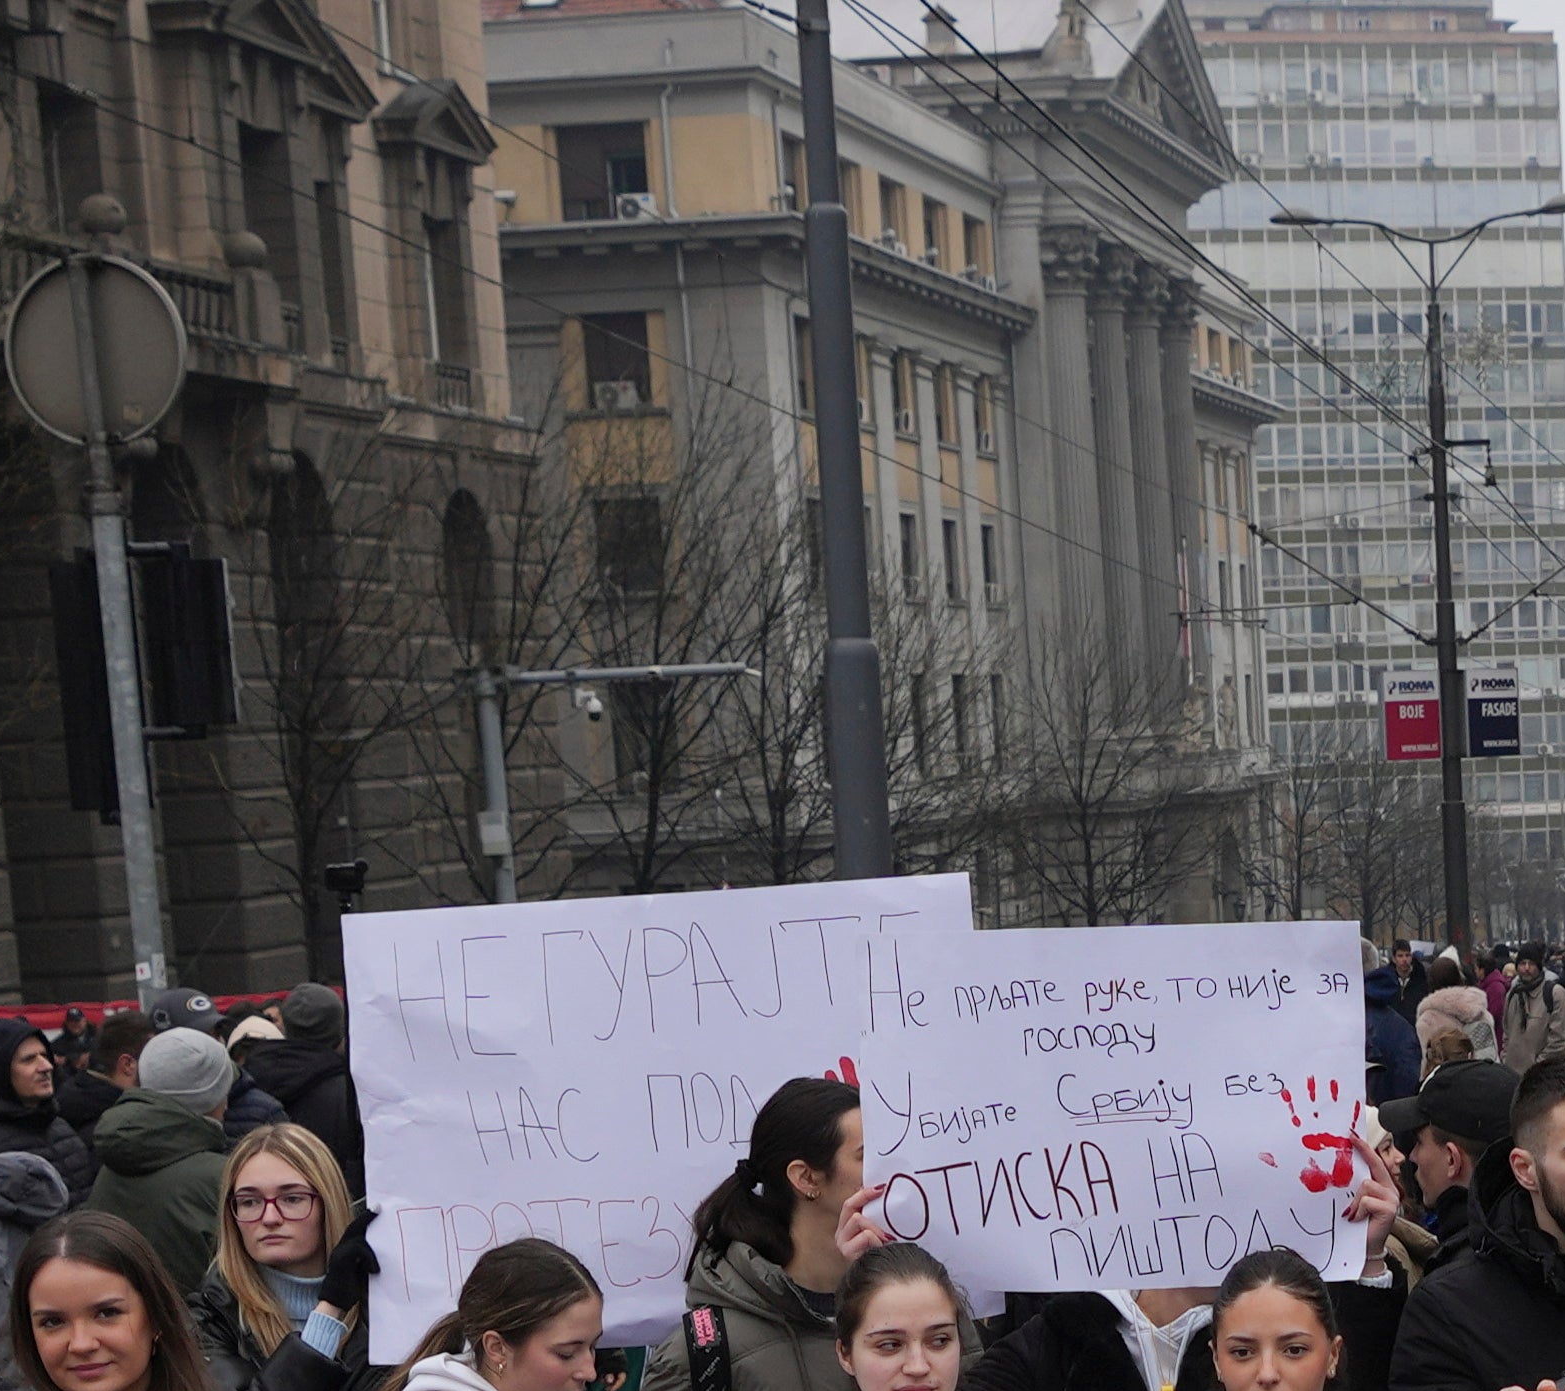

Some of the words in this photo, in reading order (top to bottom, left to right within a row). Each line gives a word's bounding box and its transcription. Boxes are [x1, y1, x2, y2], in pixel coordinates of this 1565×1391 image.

[1399, 680, 1434, 690] ROMA
[1481, 678, 1515, 688] ROMA
[1399, 704, 1425, 719] BOJE
[1481, 701, 1517, 717] FASADE
[394, 936, 517, 1061] НЕ
[466, 1086, 600, 1166] НАС
[883, 1141, 1119, 1240] ОТИСКА
[1146, 1132, 1224, 1208] НА
